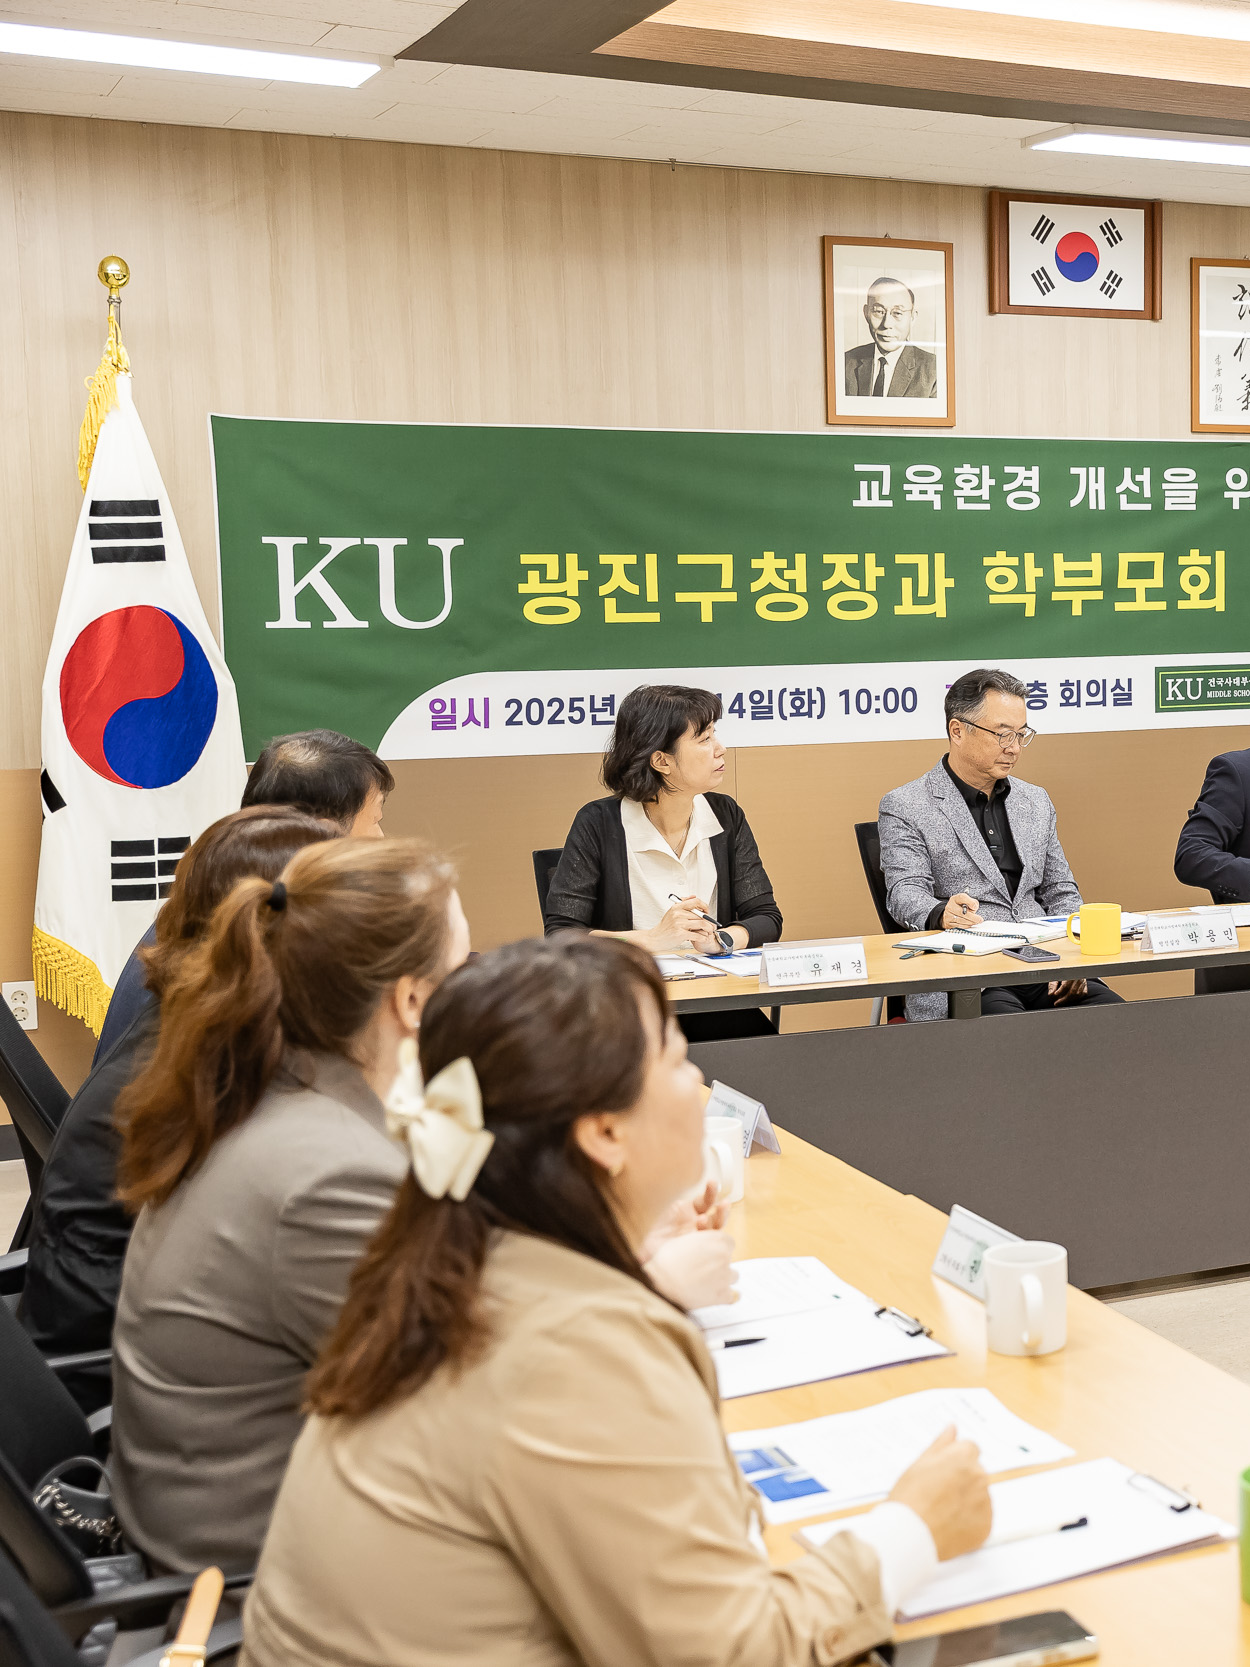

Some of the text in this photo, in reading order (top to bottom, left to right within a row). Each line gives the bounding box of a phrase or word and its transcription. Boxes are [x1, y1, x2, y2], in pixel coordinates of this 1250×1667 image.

[852, 463, 1042, 511] 교육환경
[1068, 465, 1200, 512] 개선을
[261, 536, 464, 630] KU
[517, 550, 955, 625] 광진구청장과
[982, 547, 1227, 618] 학부모회
[428, 696, 491, 731] 일시
[504, 693, 616, 728] 2025년
[838, 686, 919, 715] 10:00
[1060, 677, 1134, 708] 회의실
[1165, 678, 1204, 700] KU
[1206, 689, 1232, 698] MIDDLE
